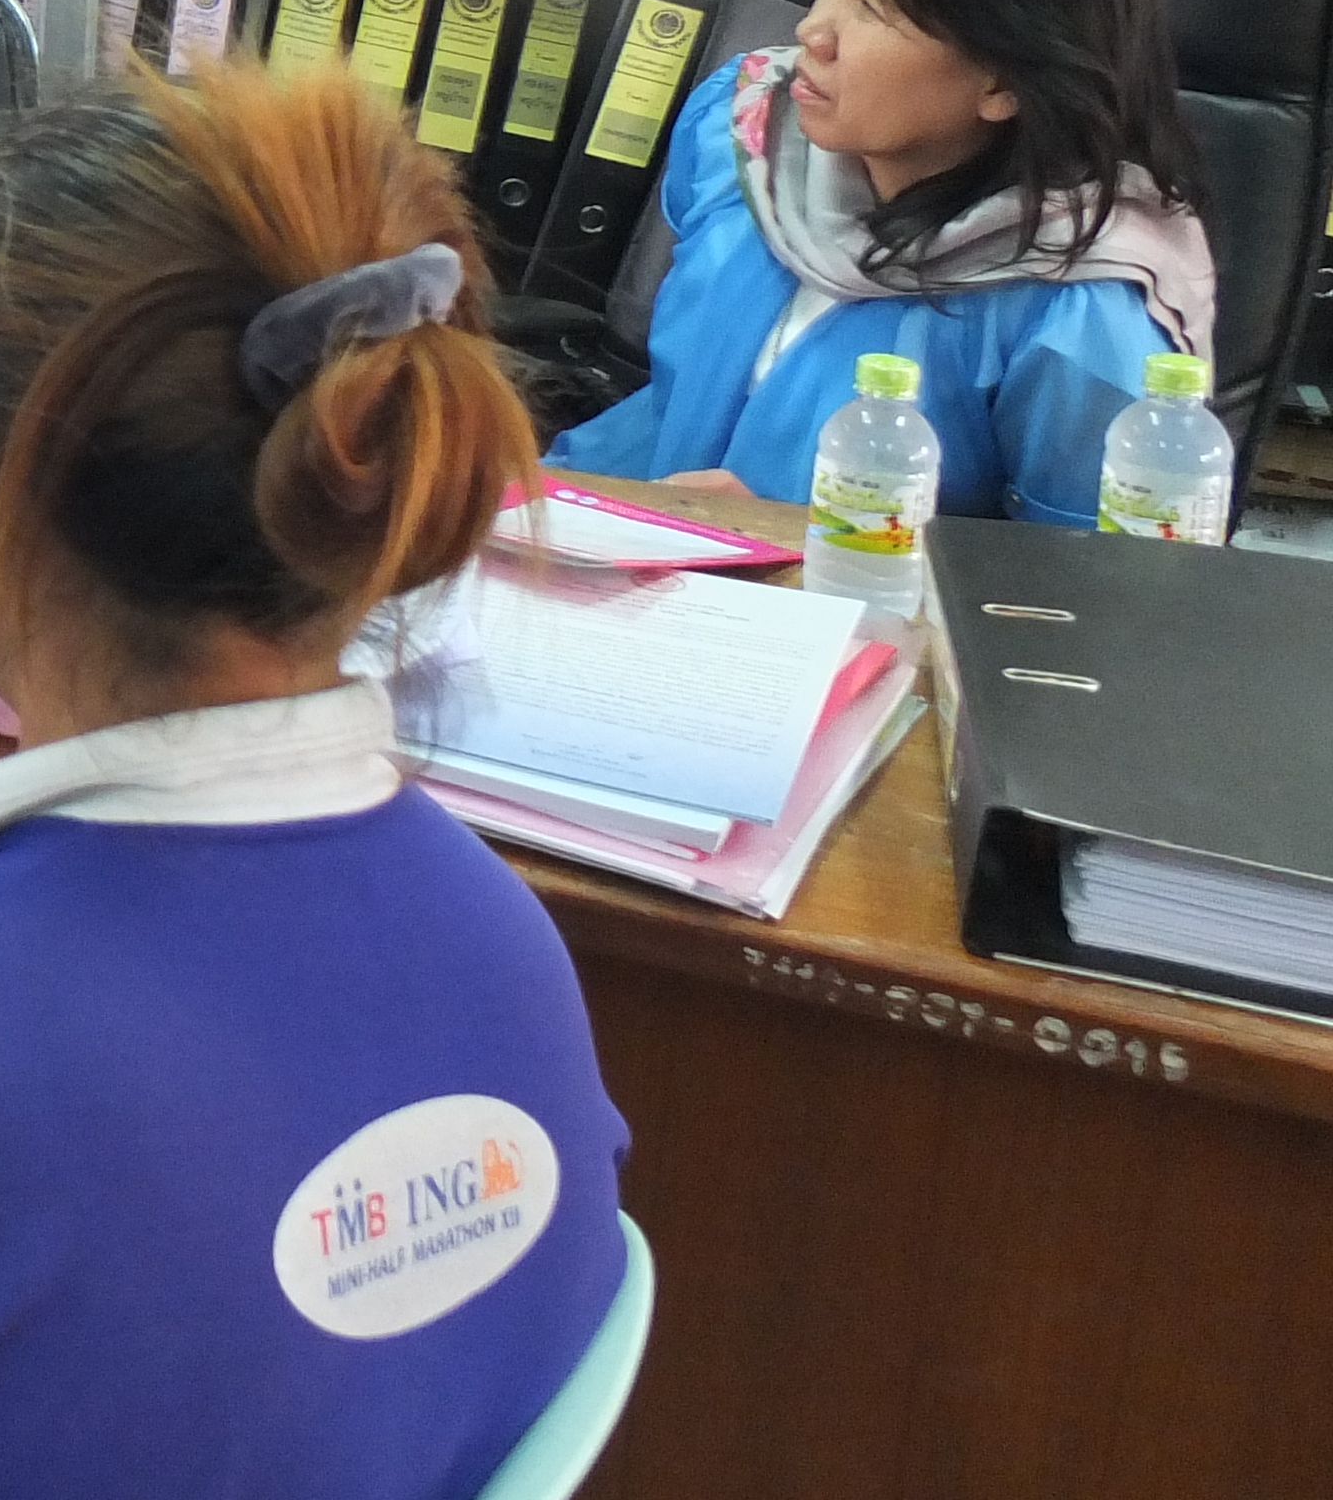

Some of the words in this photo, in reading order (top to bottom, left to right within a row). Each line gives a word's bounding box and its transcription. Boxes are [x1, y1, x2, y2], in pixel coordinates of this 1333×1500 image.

[310, 1182, 386, 1256] TMB
[404, 1158, 477, 1228] ING
[329, 1247, 406, 1297] MINI-HALF
[411, 1212, 497, 1261] MARATHON
